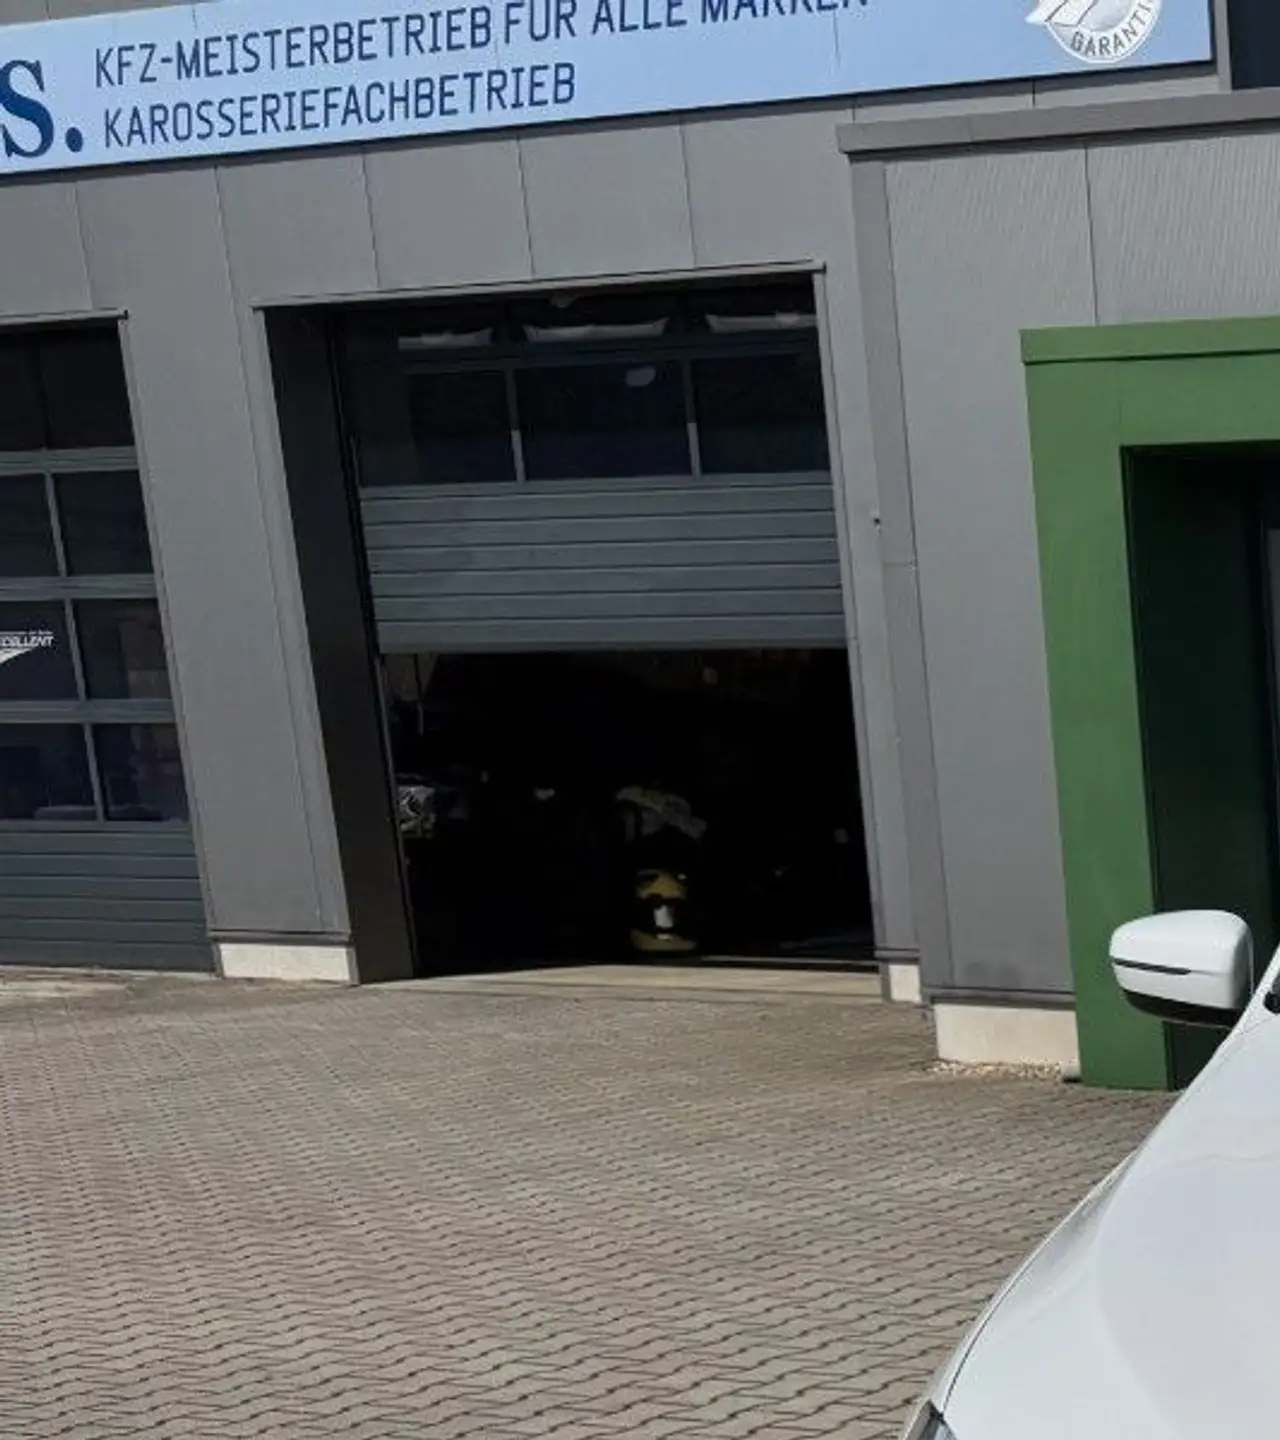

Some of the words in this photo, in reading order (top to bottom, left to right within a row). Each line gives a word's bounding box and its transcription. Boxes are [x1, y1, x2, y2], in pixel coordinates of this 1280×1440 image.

[96, 5, 492, 88] KFZ-MEISTERBETRIEB
[592, 0, 687, 35] ALLE
[1071, 2, 1152, 57] GARANTI
[105, 62, 575, 148] KAROSSERIEFACHBETRIEB
